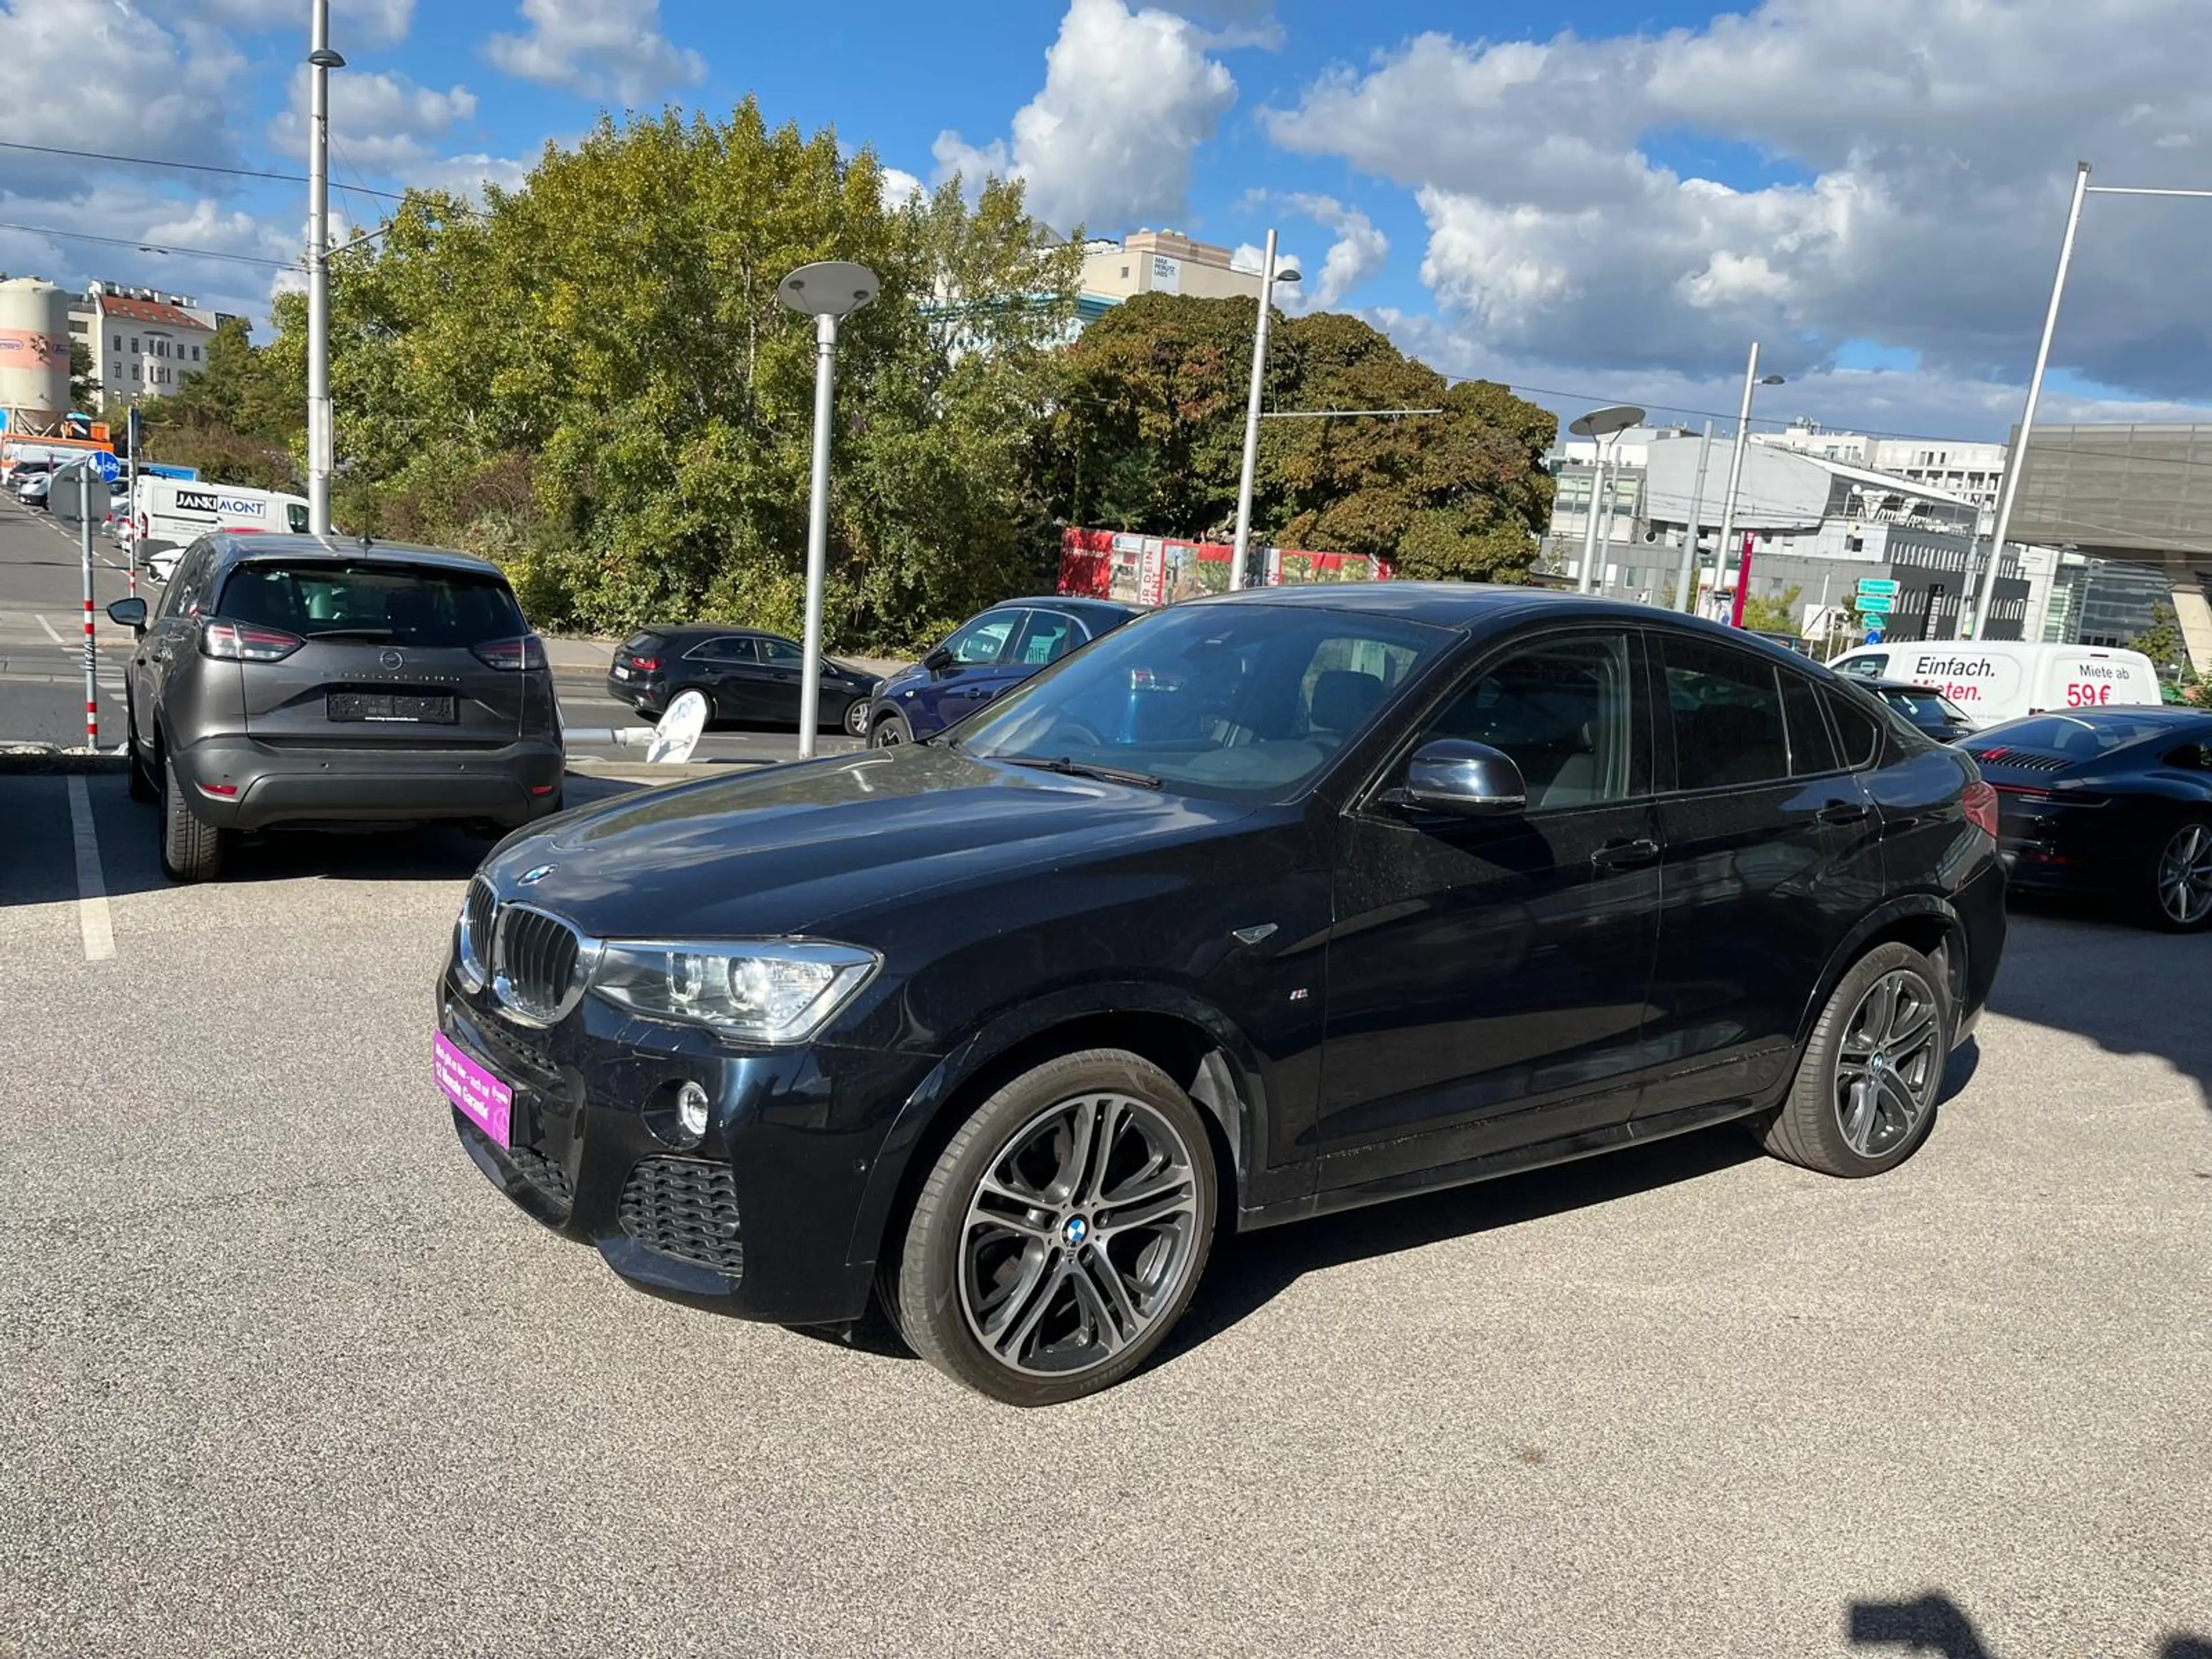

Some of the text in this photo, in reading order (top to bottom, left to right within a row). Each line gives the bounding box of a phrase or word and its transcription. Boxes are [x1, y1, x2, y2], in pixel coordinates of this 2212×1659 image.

[219, 500, 264, 514] MONT
[1916, 657, 1995, 677] Einfach.
[2080, 664, 2130, 680] Miete ab
[1913, 679, 1982, 700] eten.
